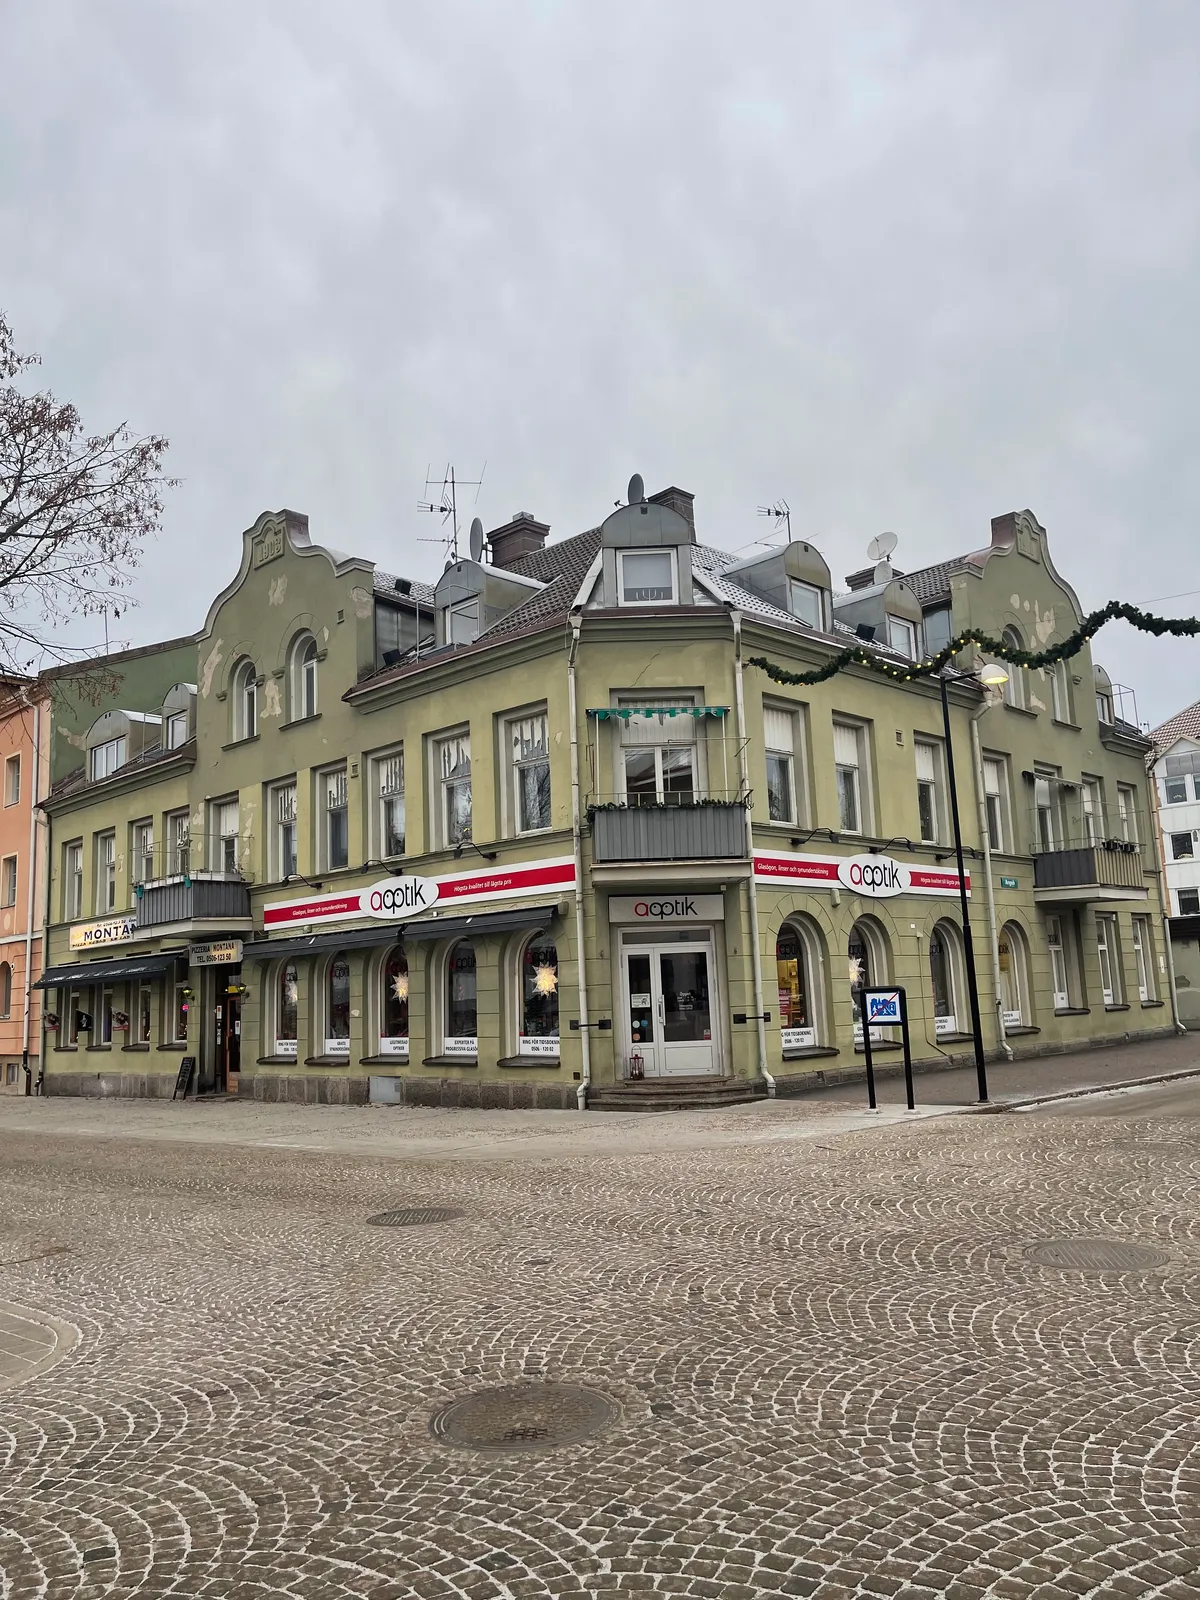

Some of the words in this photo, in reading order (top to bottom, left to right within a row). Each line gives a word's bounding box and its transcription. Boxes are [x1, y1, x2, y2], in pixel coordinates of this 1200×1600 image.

[468, 882, 483, 890] kvalitet
[503, 878, 512, 886] pris
[849, 860, 902, 892] aoptik
[370, 878, 426, 915] aoptik
[634, 896, 698, 920] aoptik
[191, 945, 210, 954] PIZZERIA
[212, 941, 235, 952] MONTANA
